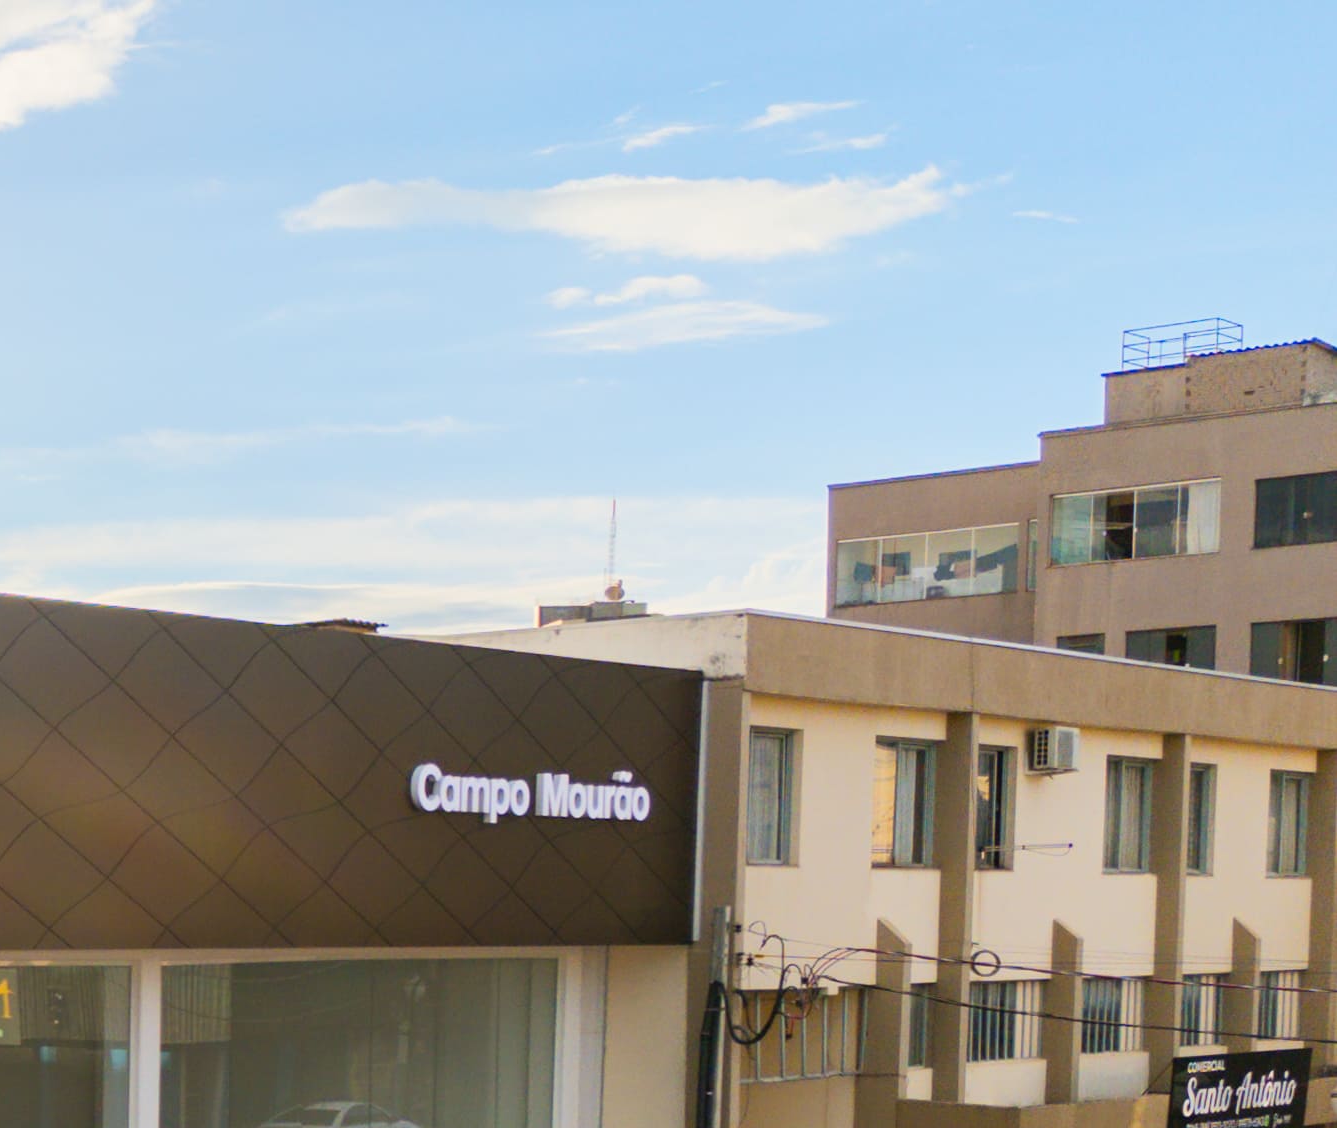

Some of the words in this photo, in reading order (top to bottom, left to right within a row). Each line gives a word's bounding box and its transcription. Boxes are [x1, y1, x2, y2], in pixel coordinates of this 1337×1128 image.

[411, 763, 530, 824] Campo
[535, 770, 650, 821] Mourão
[1187, 1060, 1225, 1074] COMERCIAL
[1182, 1077, 1233, 1118] Santo
[1235, 1070, 1297, 1115] Antônio
